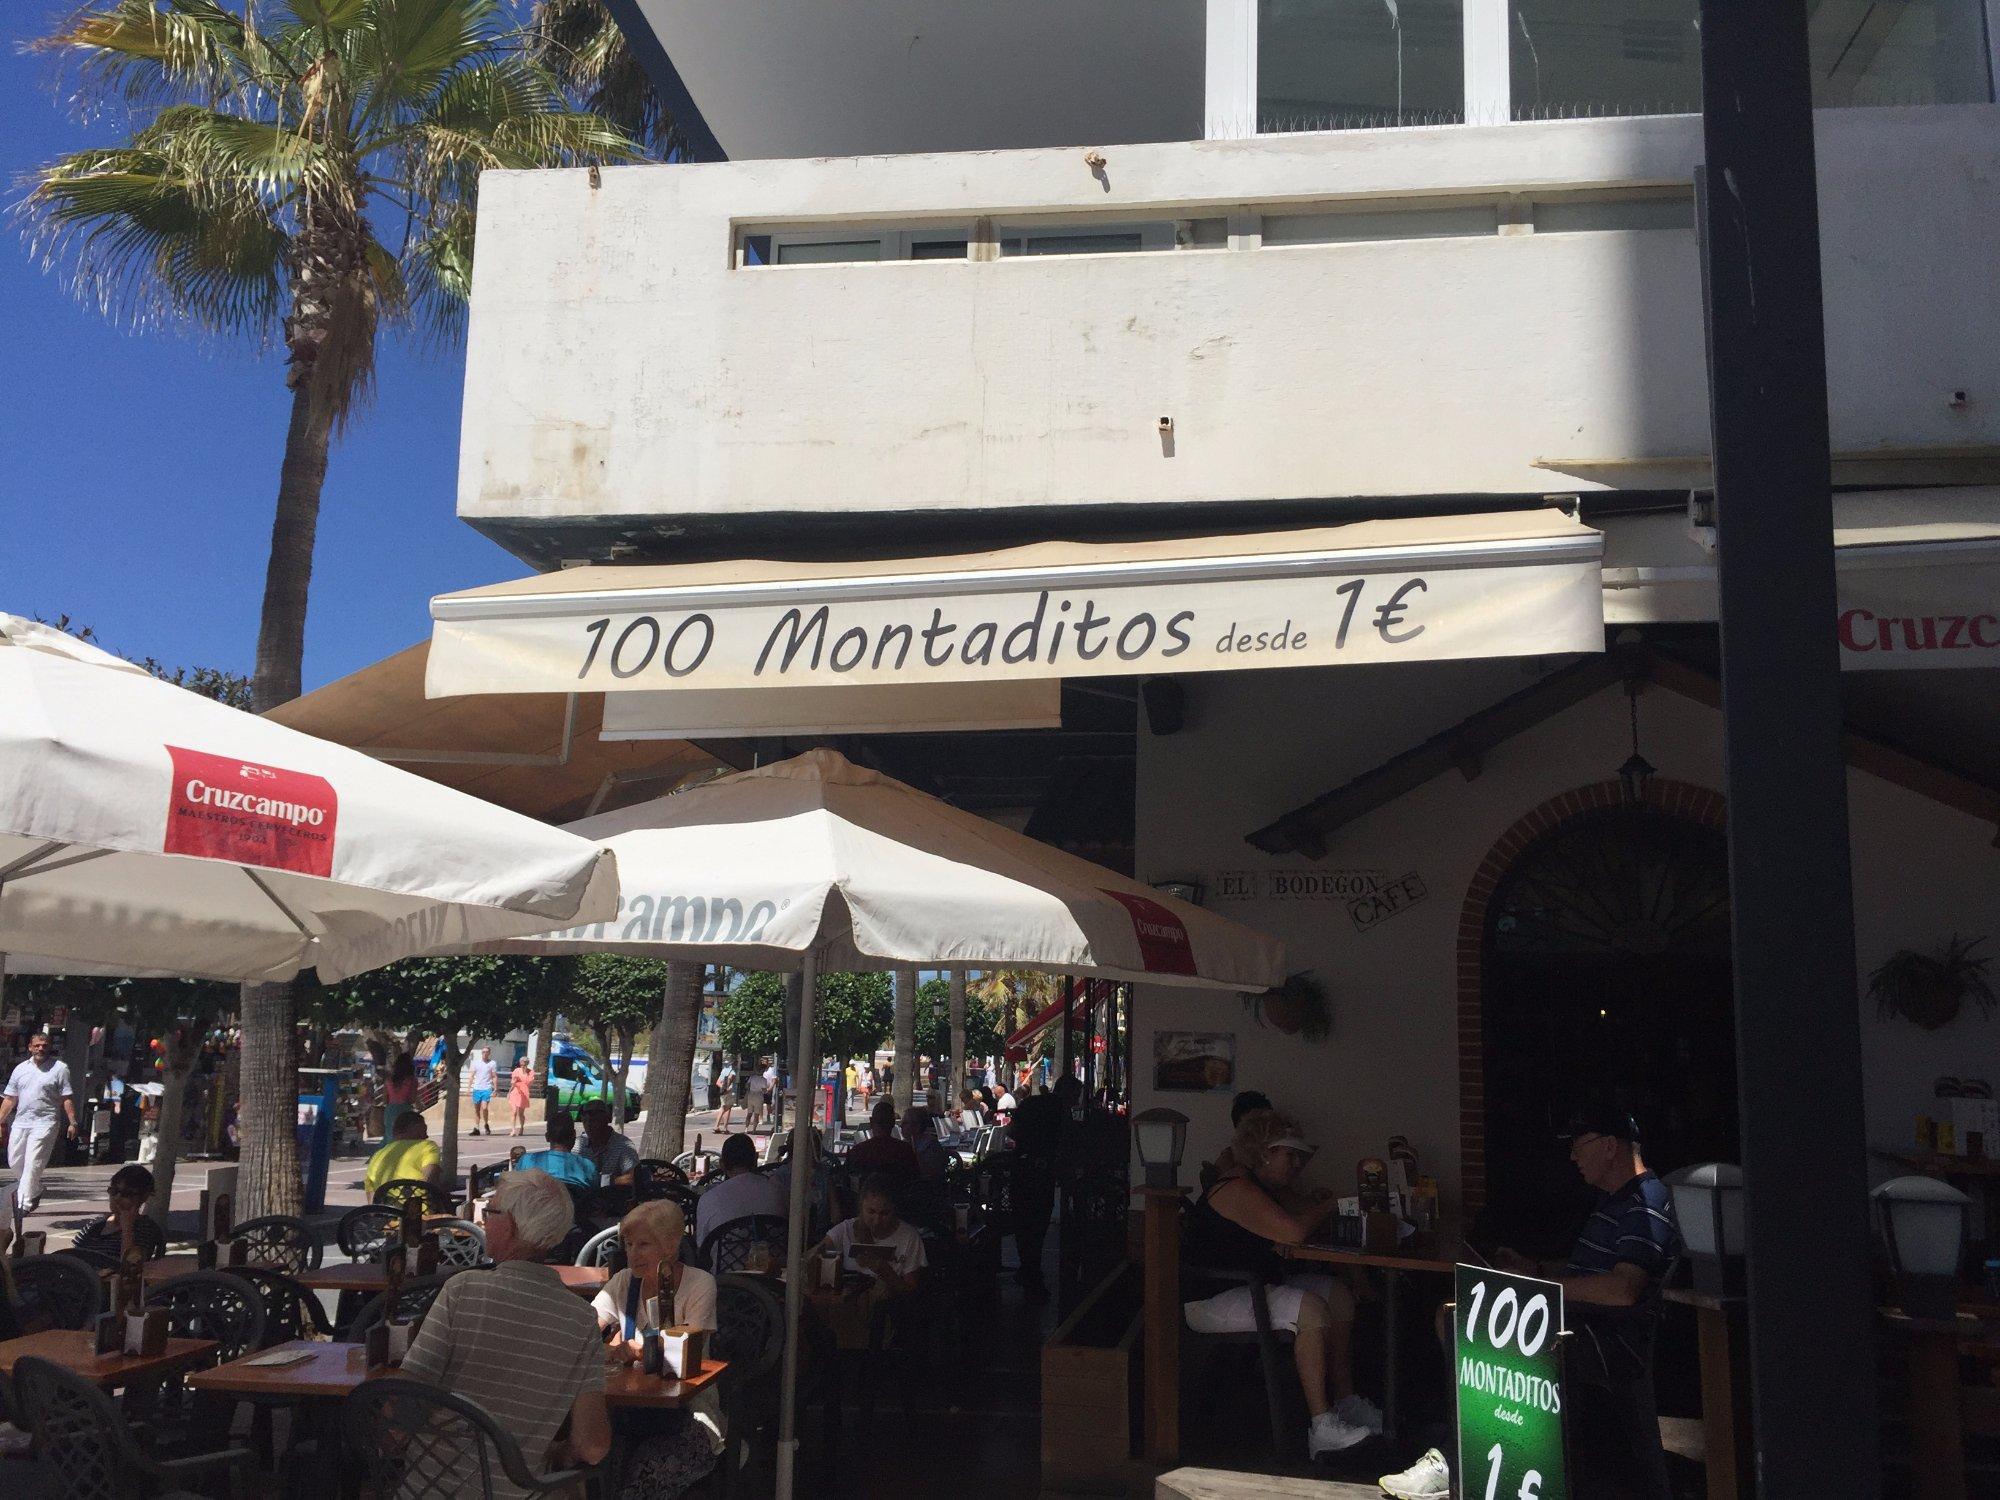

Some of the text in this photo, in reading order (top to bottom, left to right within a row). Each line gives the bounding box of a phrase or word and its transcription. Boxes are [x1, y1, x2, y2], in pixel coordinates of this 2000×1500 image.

[578, 614, 714, 679] 100
[754, 590, 1195, 676] Montaditos
[1216, 619, 1307, 653] desde
[1837, 608, 2000, 651] Cruzc
[186, 779, 326, 826] Cruzcampo
[1223, 876, 1249, 895] EL
[1136, 918, 1185, 943] Cruzcampo
[1466, 1281, 1549, 1357] 100
[1460, 1356, 1561, 1414] MONTADITOS
[1494, 1404, 1524, 1425] desde
